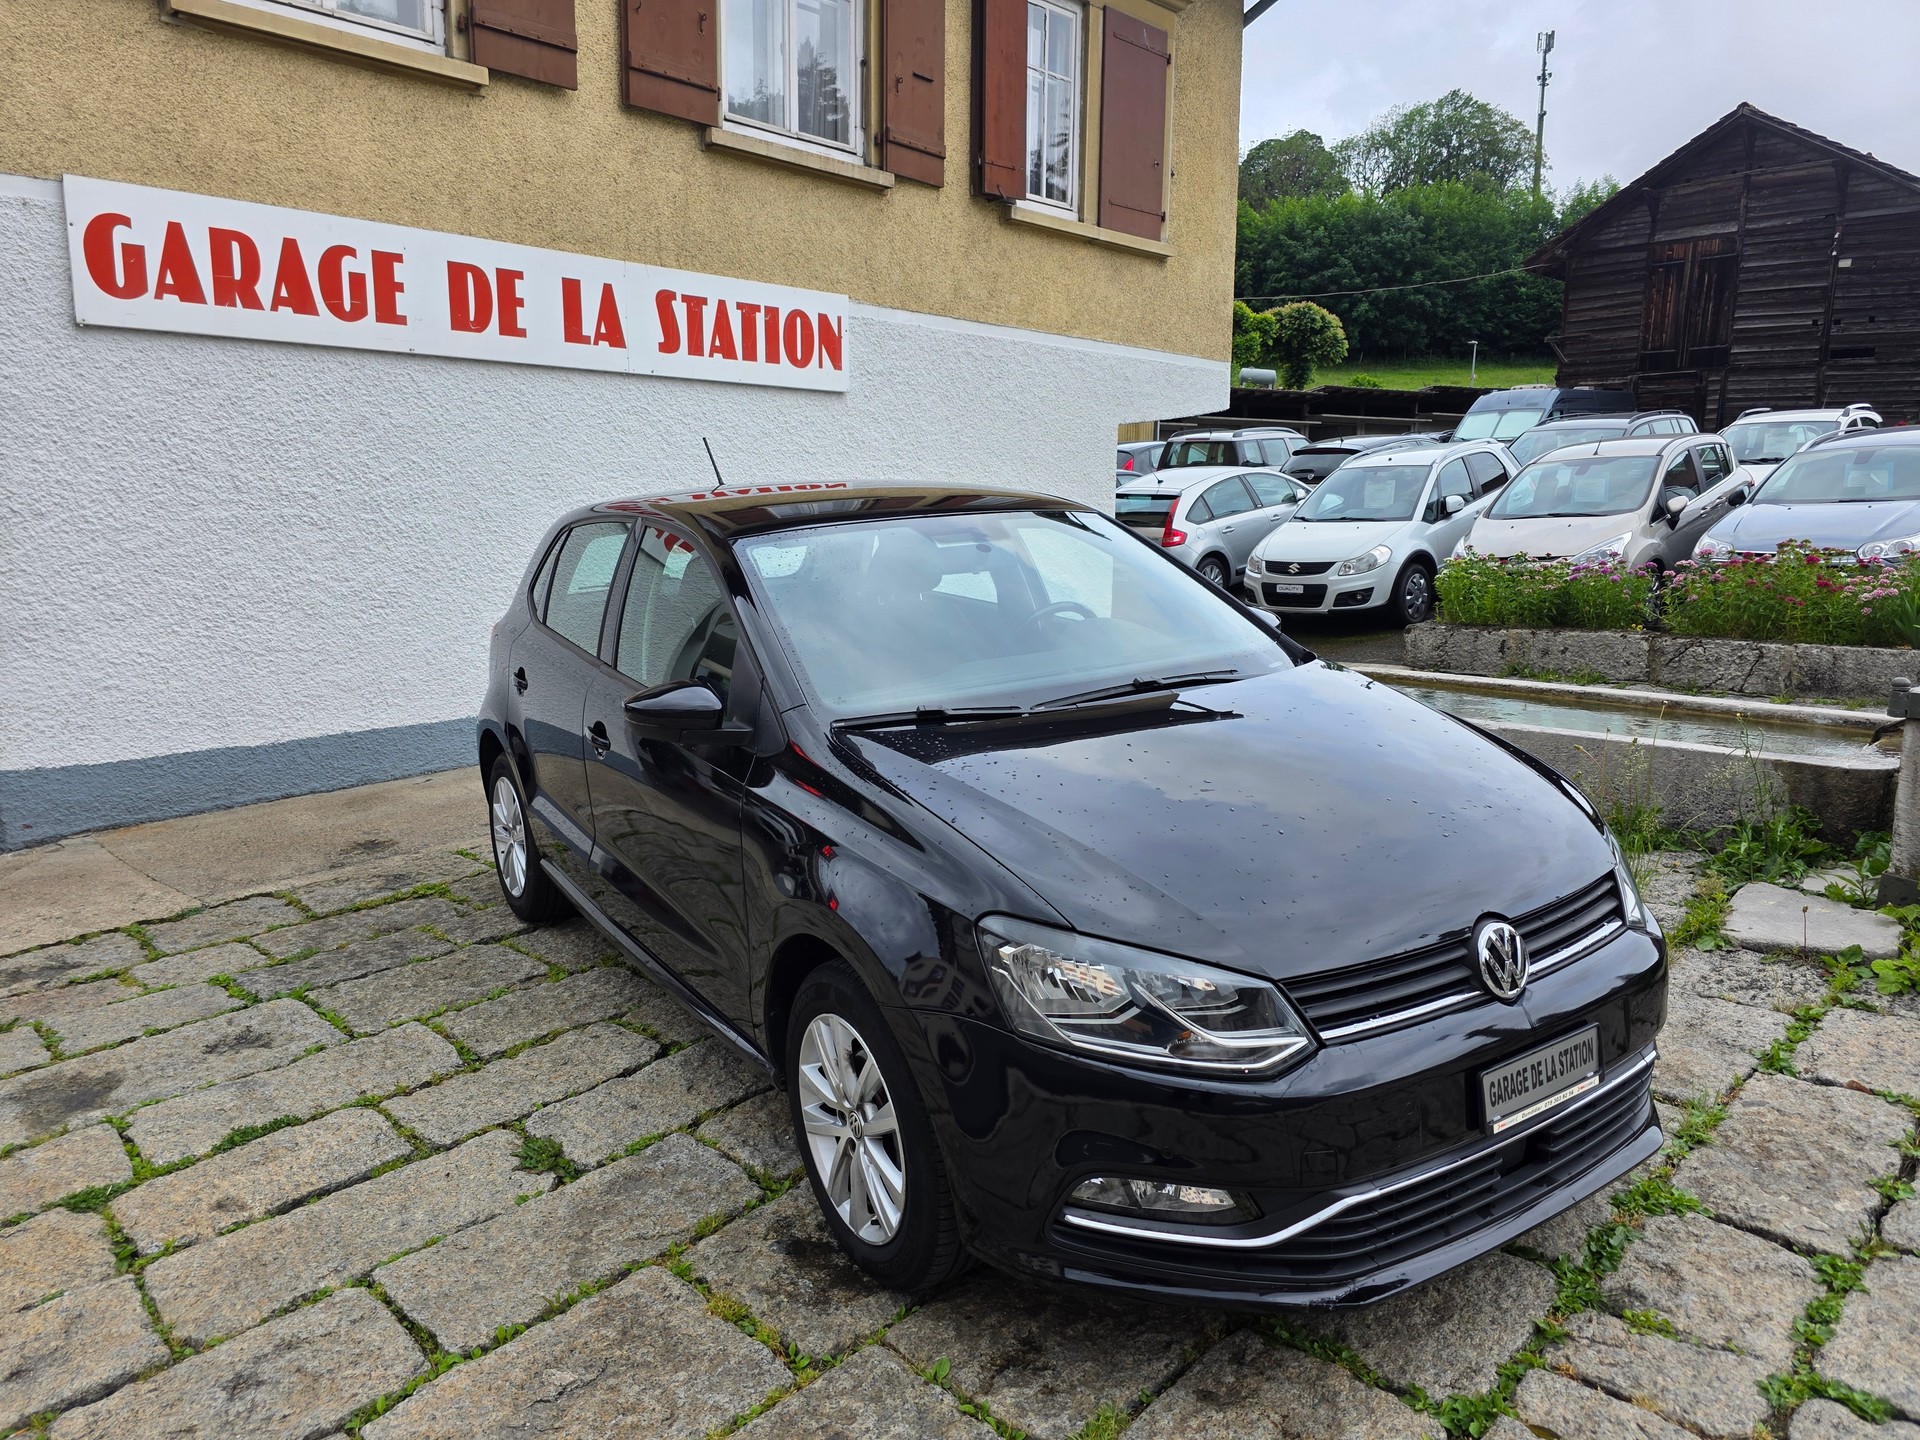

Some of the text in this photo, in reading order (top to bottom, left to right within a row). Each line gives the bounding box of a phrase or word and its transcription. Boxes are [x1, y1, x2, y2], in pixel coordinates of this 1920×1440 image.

[82, 212, 844, 371] GARAGE DE LA STATION
[1489, 1067, 1530, 1108] GARAGE
[1530, 1060, 1544, 1090] DE
[1544, 1054, 1558, 1083] LA
[1558, 1037, 1594, 1077] STATION
